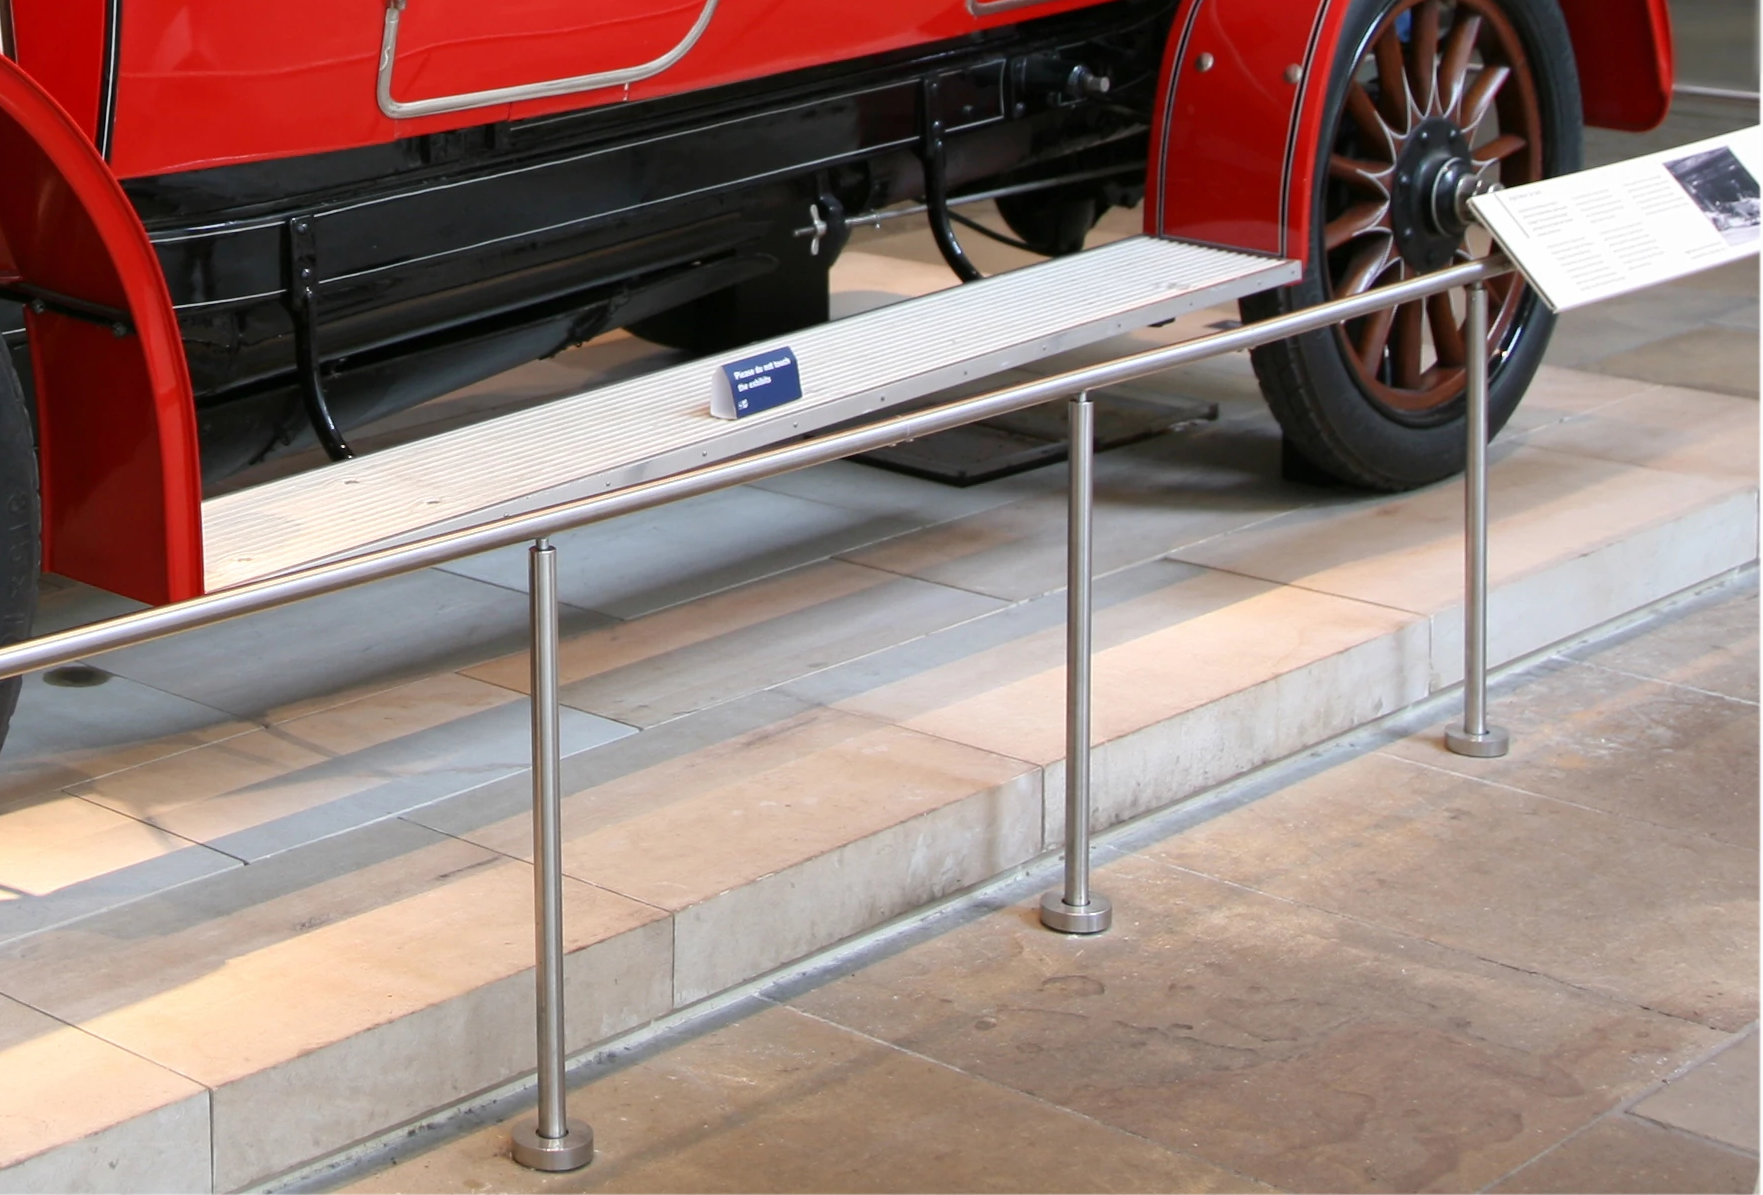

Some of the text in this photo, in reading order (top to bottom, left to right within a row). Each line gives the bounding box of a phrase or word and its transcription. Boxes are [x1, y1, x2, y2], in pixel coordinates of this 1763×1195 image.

[733, 356, 791, 380] Please do not touch
[737, 375, 772, 392] the exhibits
